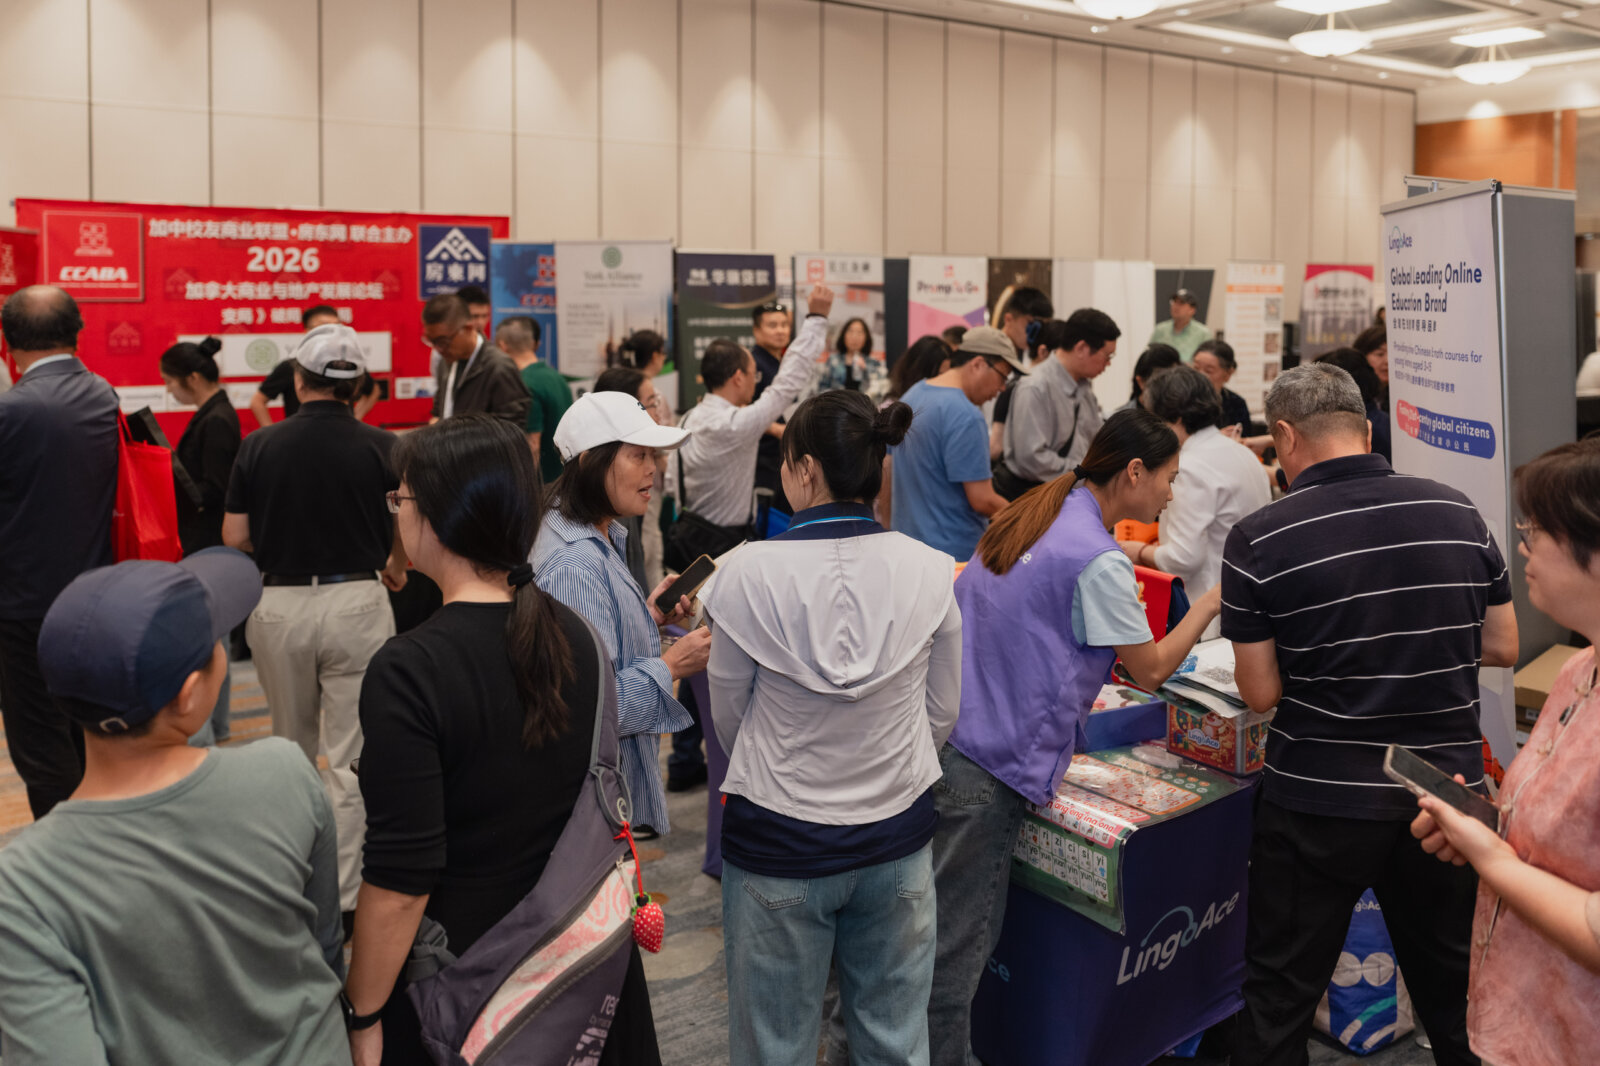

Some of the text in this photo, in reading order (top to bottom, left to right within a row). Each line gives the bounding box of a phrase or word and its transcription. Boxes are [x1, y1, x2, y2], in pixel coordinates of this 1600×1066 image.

[247, 246, 320, 273] 2026
[59, 266, 128, 281] CCABA
[1391, 261, 1483, 290] Global Leading Online
[1425, 291, 1448, 313] Brand
[1445, 351, 1469, 363] courses
[1470, 350, 1483, 363] for
[1432, 417, 1454, 432] global
[1455, 421, 1490, 439] citizens
[1188, 731, 1220, 748] LingoAce
[1055, 837, 1062, 847] zi
[1068, 843, 1075, 853] ci
[1082, 848, 1089, 859] si
[1096, 855, 1104, 866] yi
[1355, 899, 1381, 912] goAc
[1116, 892, 1240, 986] LingoAce
